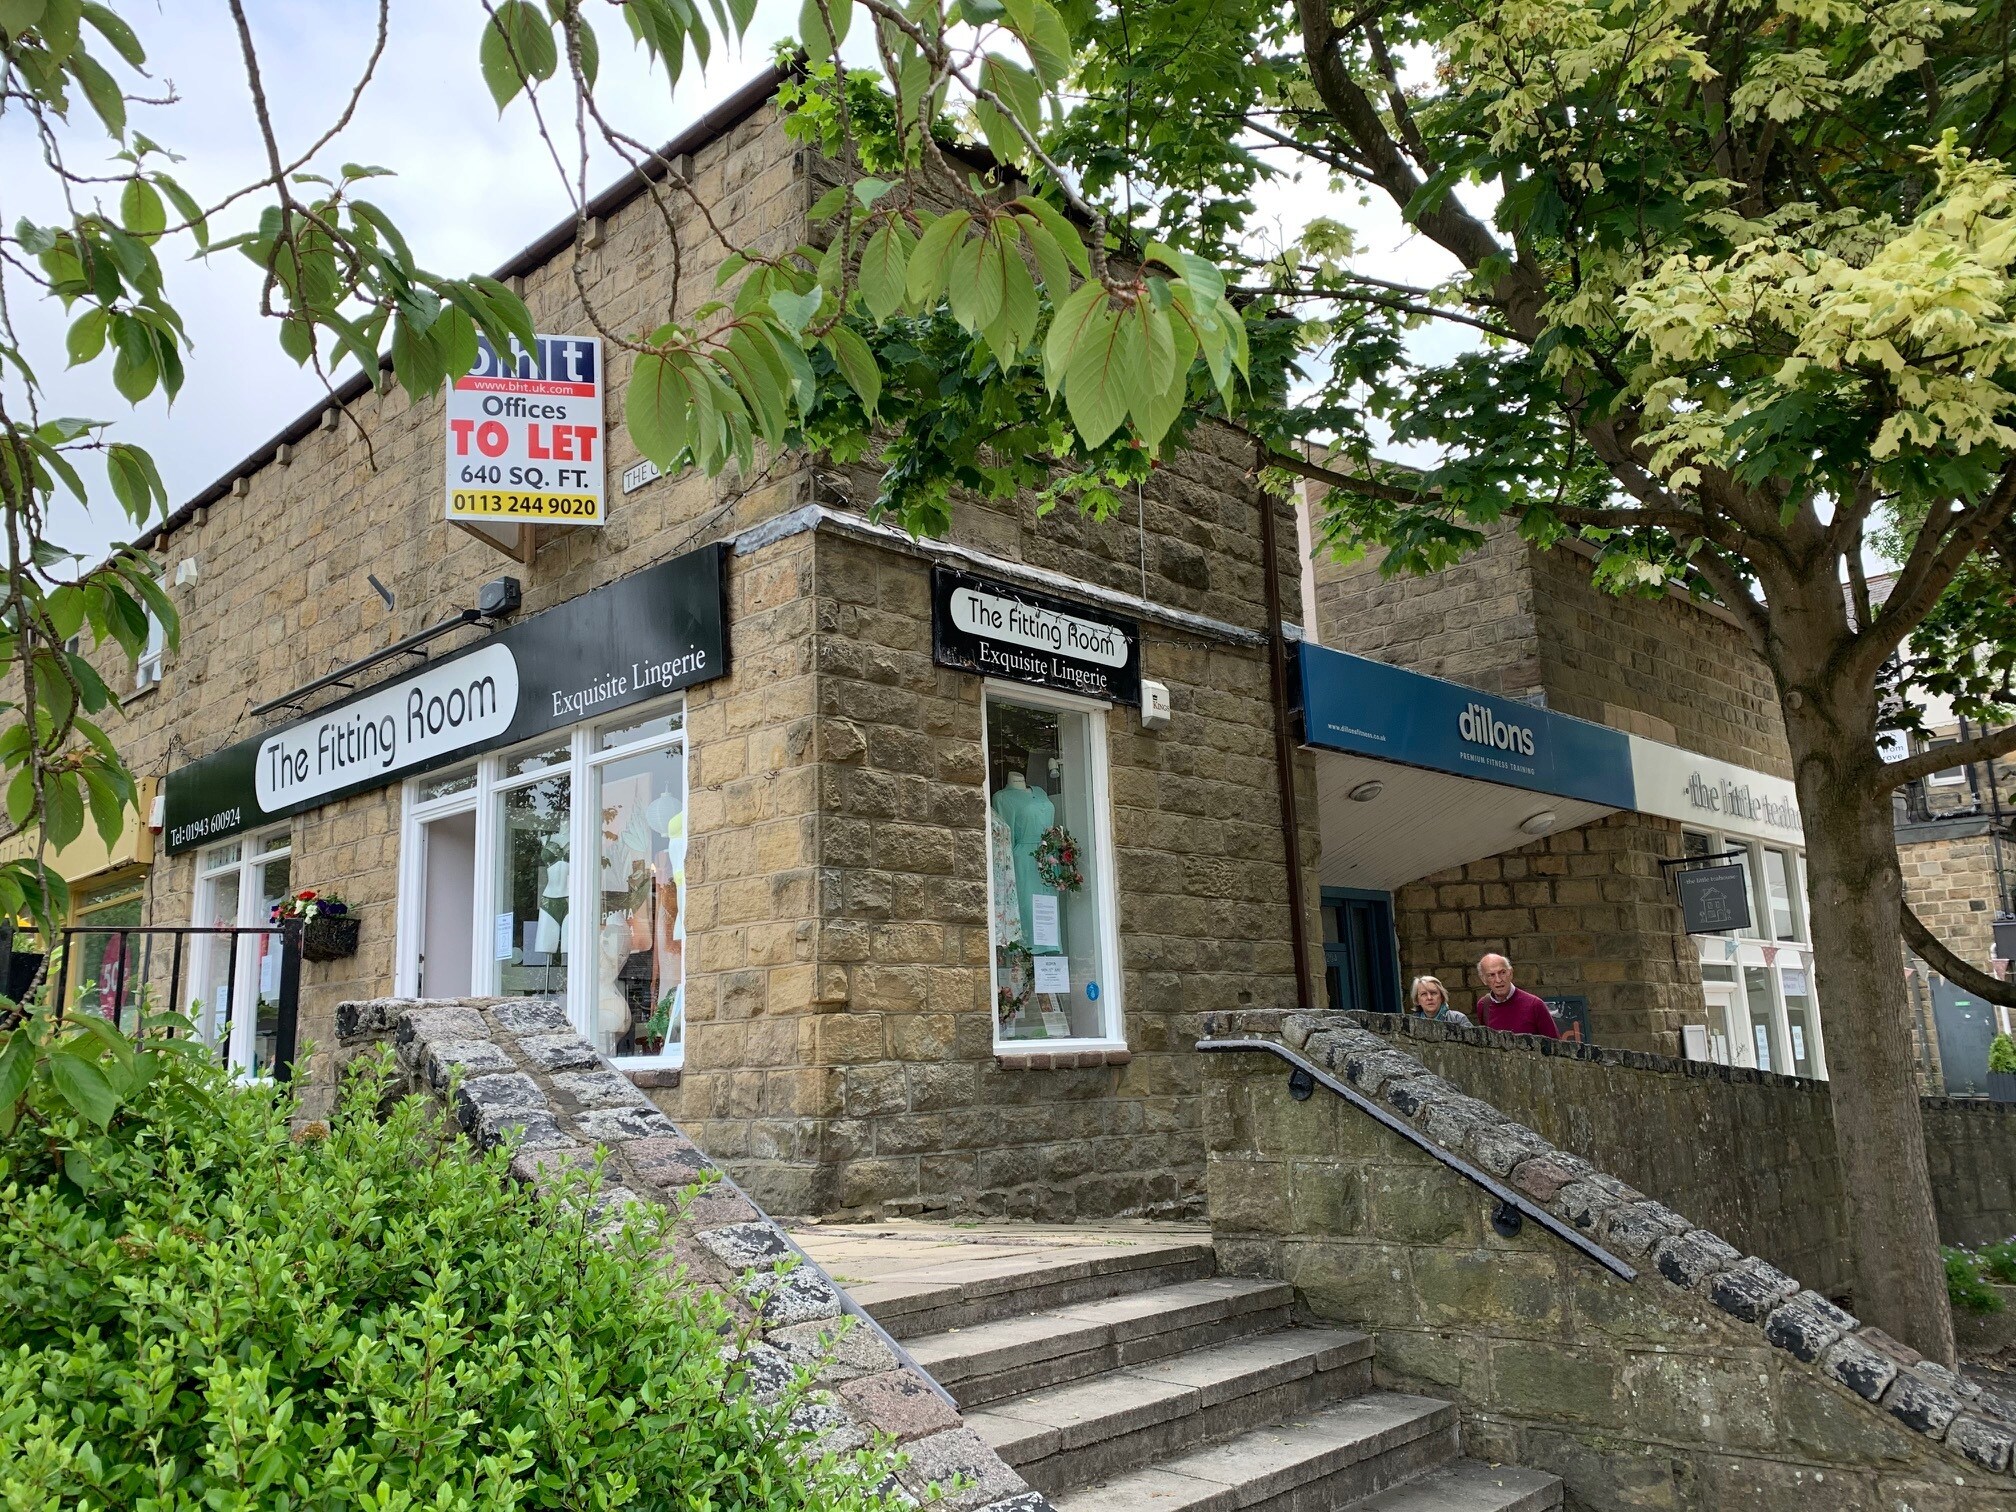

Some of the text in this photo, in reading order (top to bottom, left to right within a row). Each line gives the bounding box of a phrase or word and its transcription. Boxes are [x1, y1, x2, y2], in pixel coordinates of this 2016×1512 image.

[474, 381, 574, 395] www.bht.uk.com
[482, 395, 567, 419] Offices
[450, 418, 598, 462] TO LET
[460, 464, 589, 490] 640 SQ. FT.
[626, 464, 648, 488] THE
[454, 494, 596, 516] 0113 244 9020
[968, 596, 1115, 656] The Fitting Room
[552, 644, 706, 717] Exquisite Lingerie
[979, 640, 1107, 688] Exquisite Lingerie
[267, 675, 496, 792] The Fitting Room
[1459, 702, 1535, 756] dillons
[1460, 751, 1535, 775] PREMIUM FITNESS TRAINING
[1689, 770, 1720, 812] the
[1720, 778, 1762, 822] little
[210, 806, 241, 833] 600924
